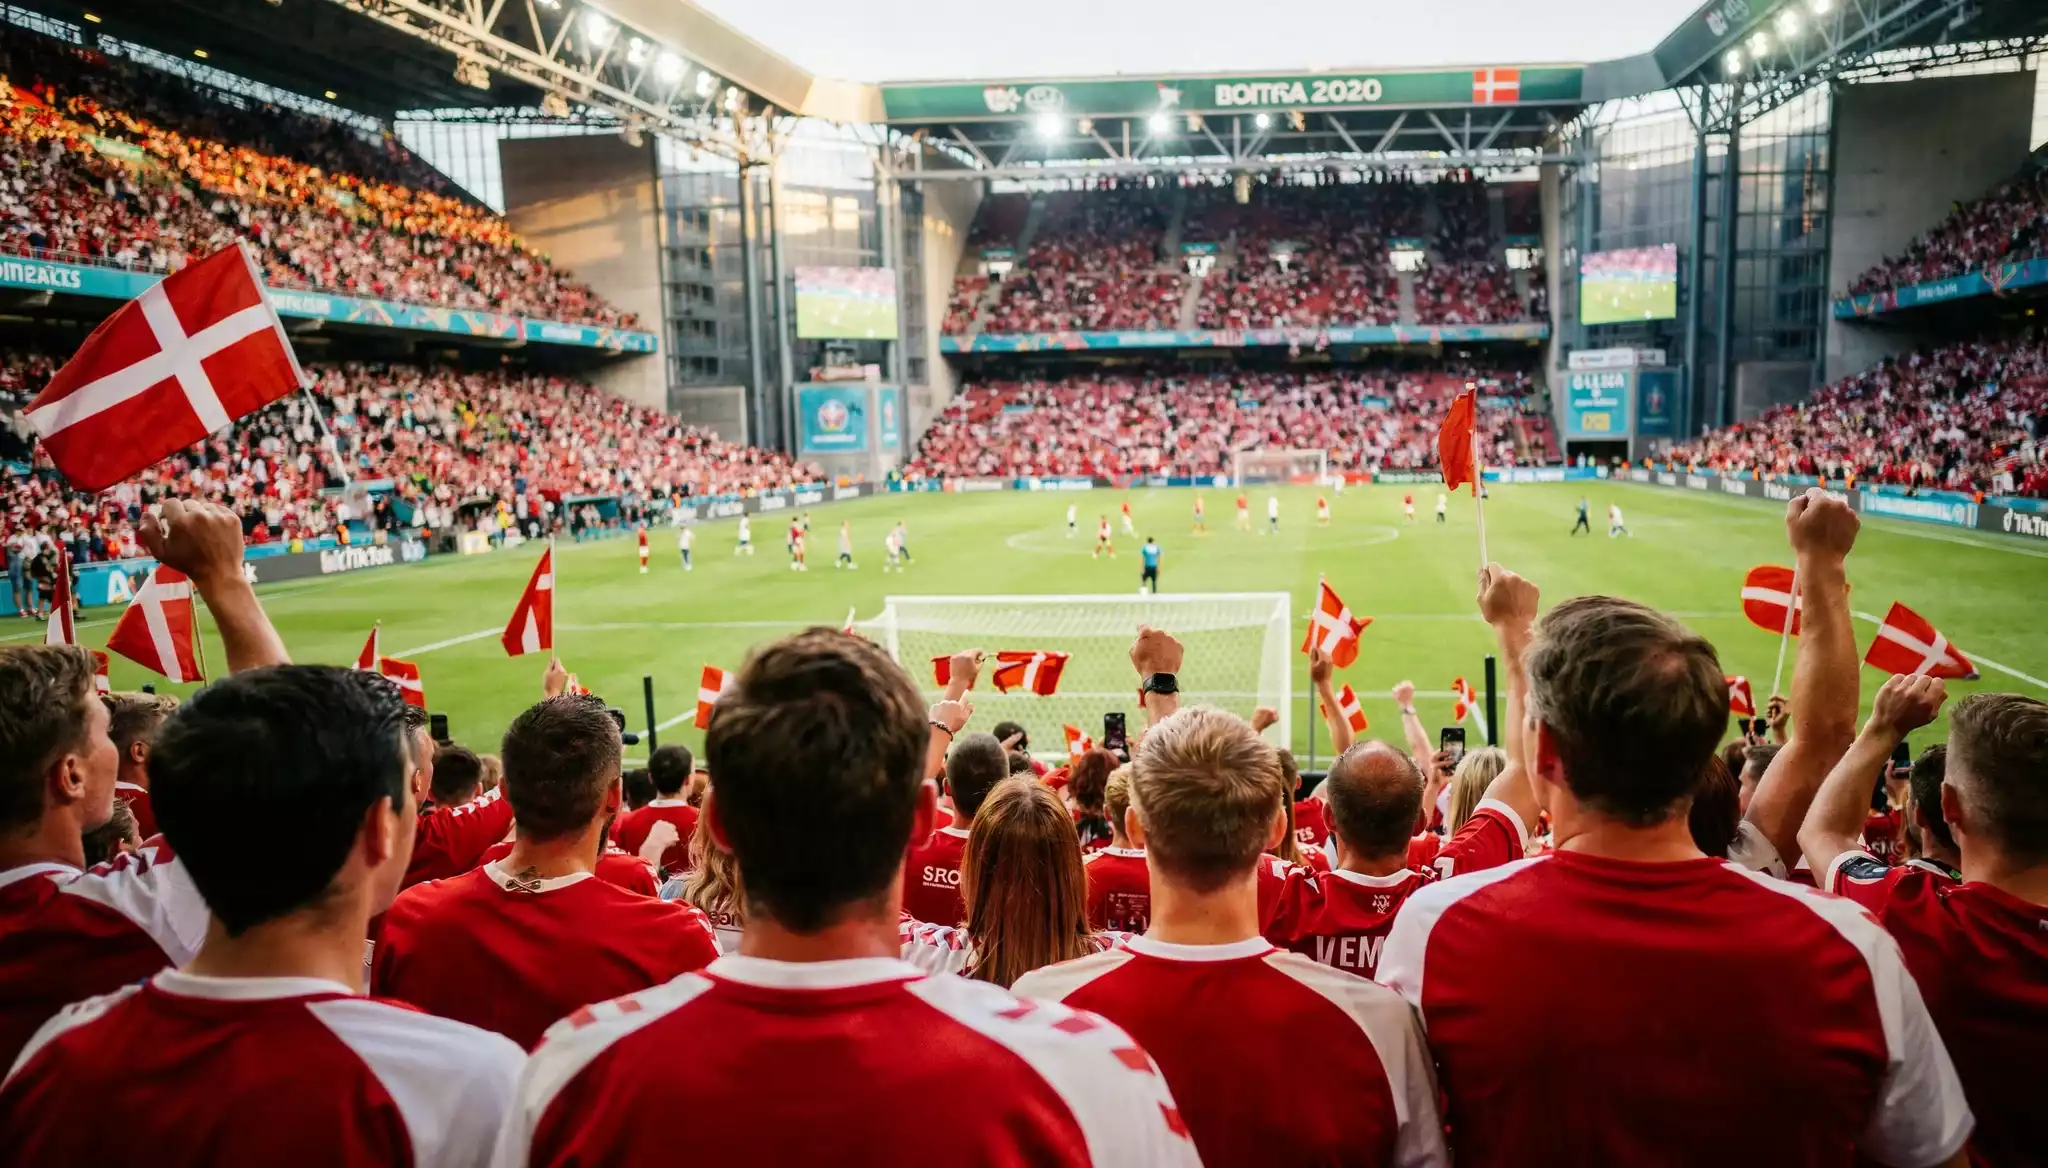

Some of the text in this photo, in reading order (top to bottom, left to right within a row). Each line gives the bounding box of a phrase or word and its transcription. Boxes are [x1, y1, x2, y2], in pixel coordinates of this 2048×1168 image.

[1310, 78, 1383, 104] 2020
[922, 865, 961, 886] SRO
[1316, 935, 1385, 968] VEM
